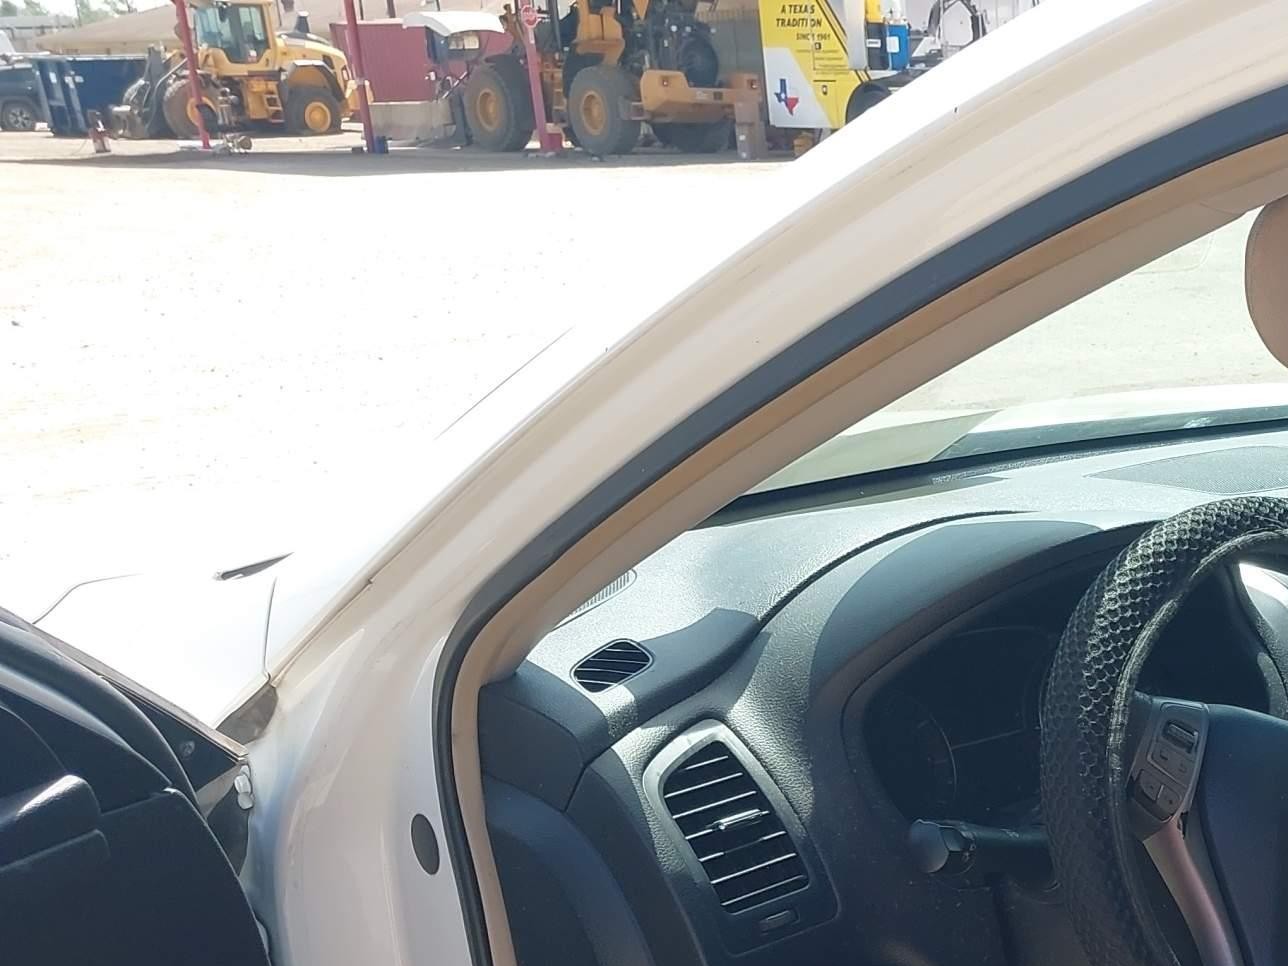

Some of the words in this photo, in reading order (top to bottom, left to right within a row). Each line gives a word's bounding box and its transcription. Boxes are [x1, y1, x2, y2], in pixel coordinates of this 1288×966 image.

[781, 5, 787, 14] A
[788, 5, 815, 14] TEXAS
[776, 18, 822, 28] TRADITION
